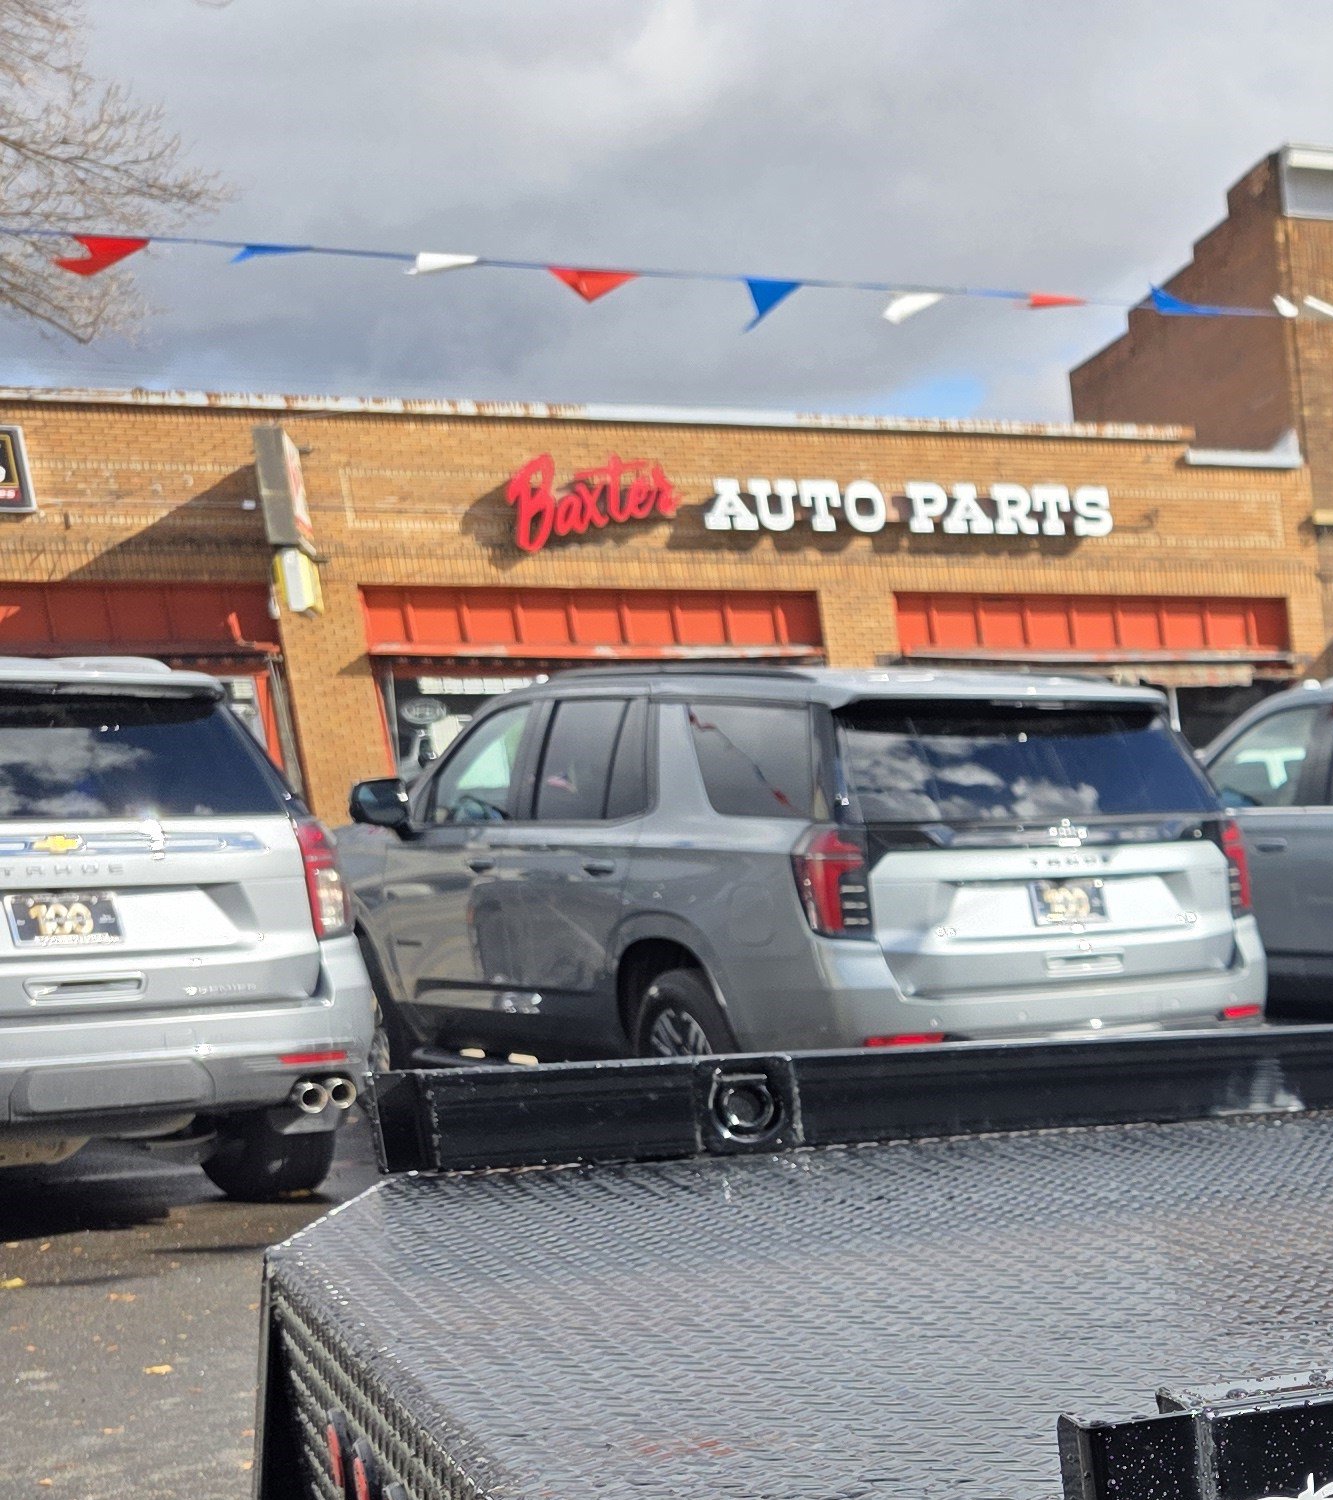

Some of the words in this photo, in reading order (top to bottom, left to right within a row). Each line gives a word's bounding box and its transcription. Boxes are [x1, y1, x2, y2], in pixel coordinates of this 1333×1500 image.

[506, 452, 681, 553] Baxter
[704, 477, 887, 533] AUTO
[905, 480, 1114, 537] PARTS
